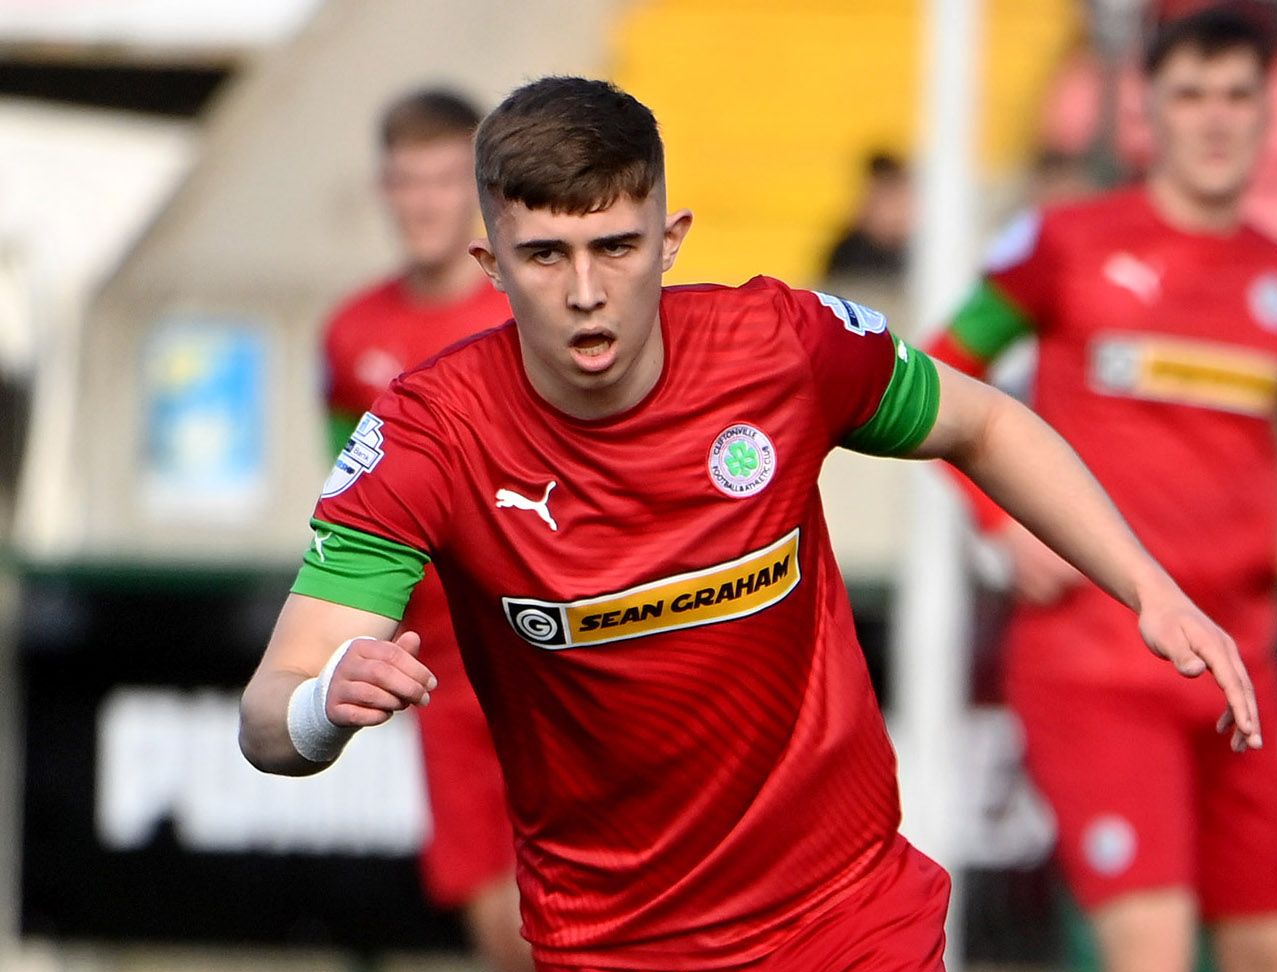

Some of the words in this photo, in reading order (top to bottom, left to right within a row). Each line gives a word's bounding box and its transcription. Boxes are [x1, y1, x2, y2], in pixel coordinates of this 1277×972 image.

[713, 427, 757, 456] CLIFTONVILLE
[579, 600, 664, 633] SEAN
[670, 554, 790, 613] GRAHAM
